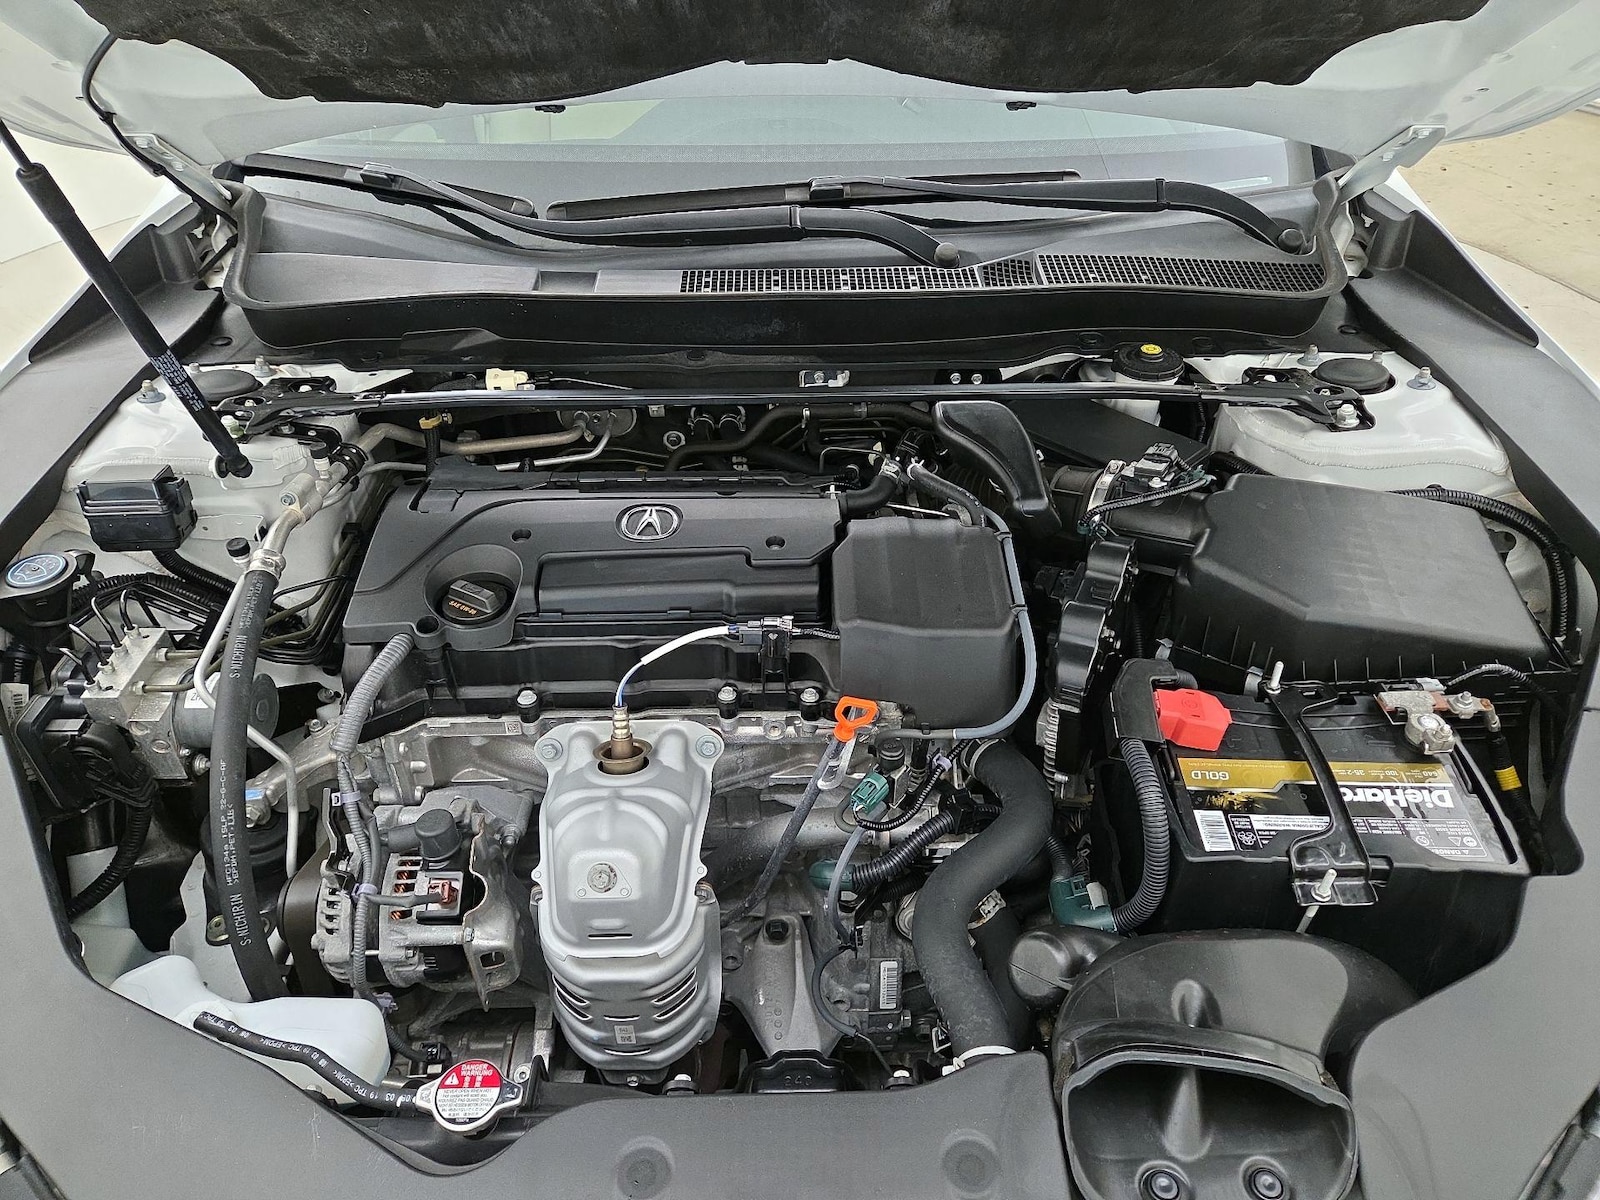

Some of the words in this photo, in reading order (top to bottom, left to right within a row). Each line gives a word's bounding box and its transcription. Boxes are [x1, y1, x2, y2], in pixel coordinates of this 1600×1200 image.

[448, 600, 462, 609] SAE
[1191, 770, 1229, 780] GOLD
[353, 1086, 367, 1097] TPC
[385, 1093, 395, 1101] 03
